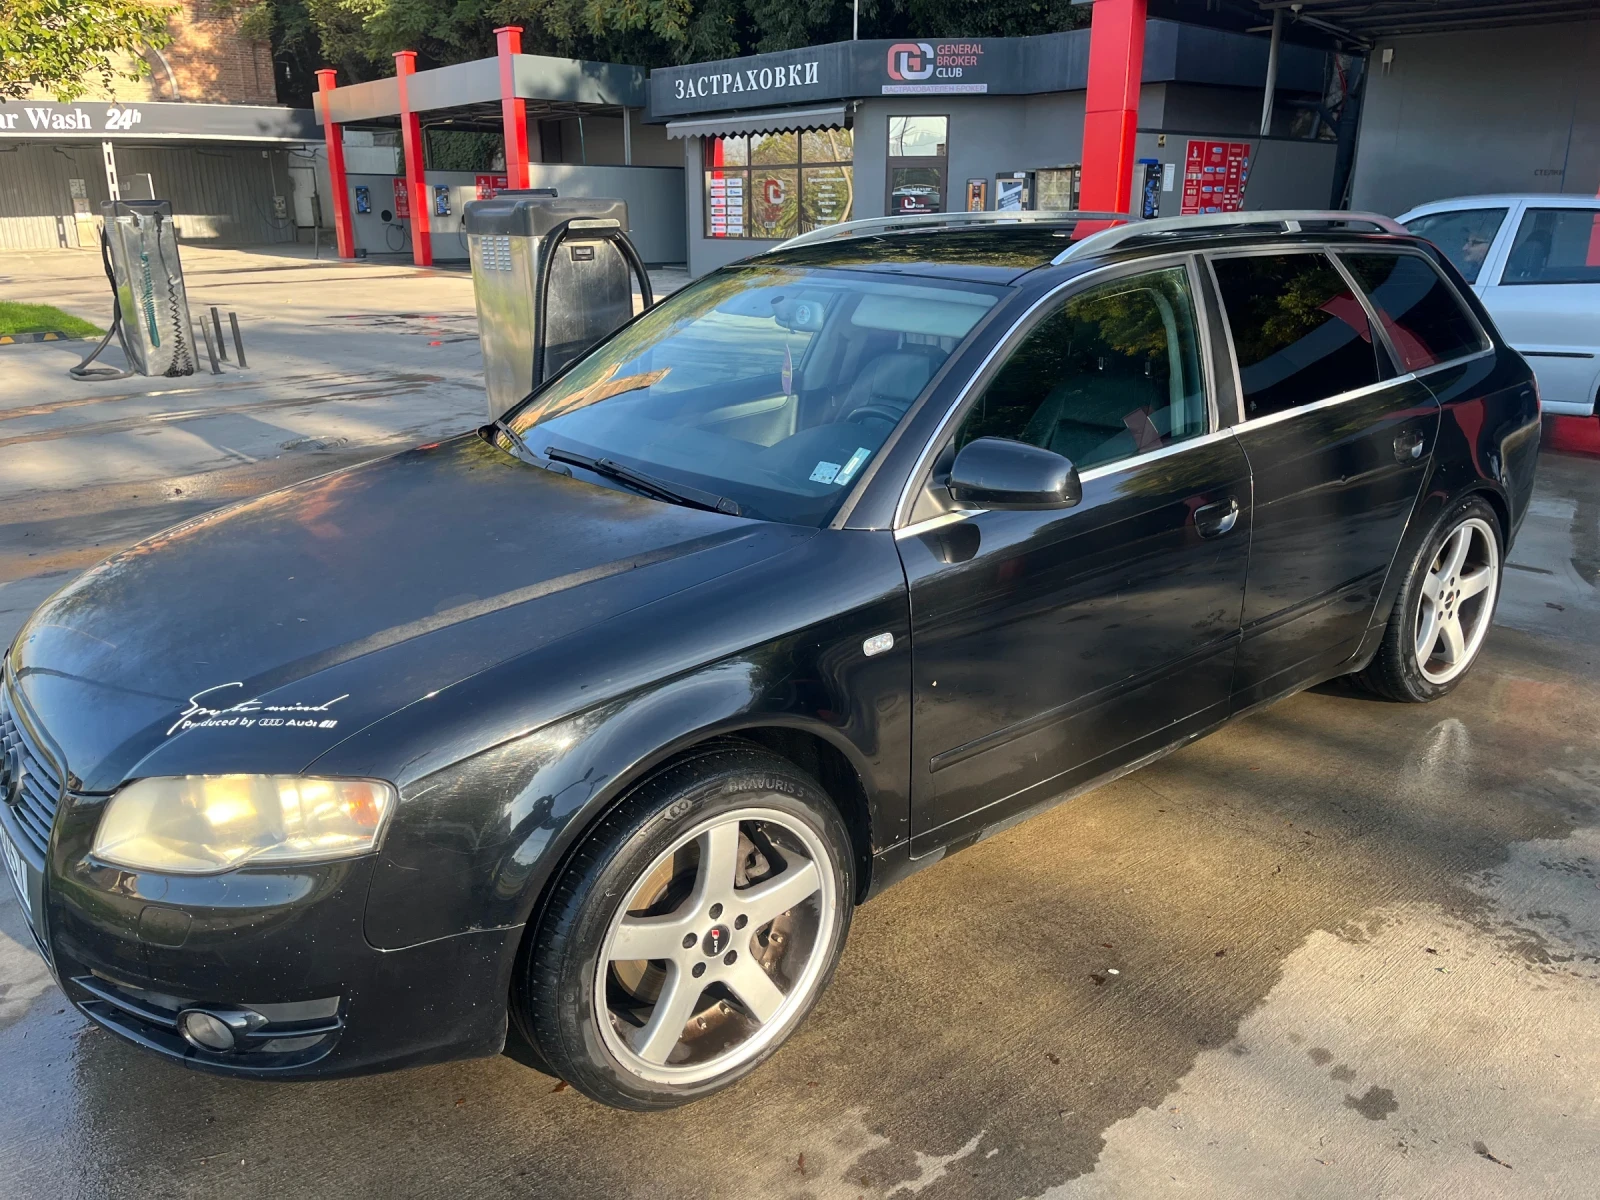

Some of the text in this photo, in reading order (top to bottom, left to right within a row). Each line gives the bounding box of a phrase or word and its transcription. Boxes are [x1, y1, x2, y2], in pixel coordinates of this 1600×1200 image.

[937, 44, 984, 55] GENERAL
[936, 55, 977, 67] BROKER
[935, 67, 963, 78] CLUB
[675, 61, 819, 99] ЗАСТРАХОВКИ
[24, 107, 92, 129] Wash
[105, 108, 142, 129] 24h
[181, 717, 318, 730] Produced by Audi
